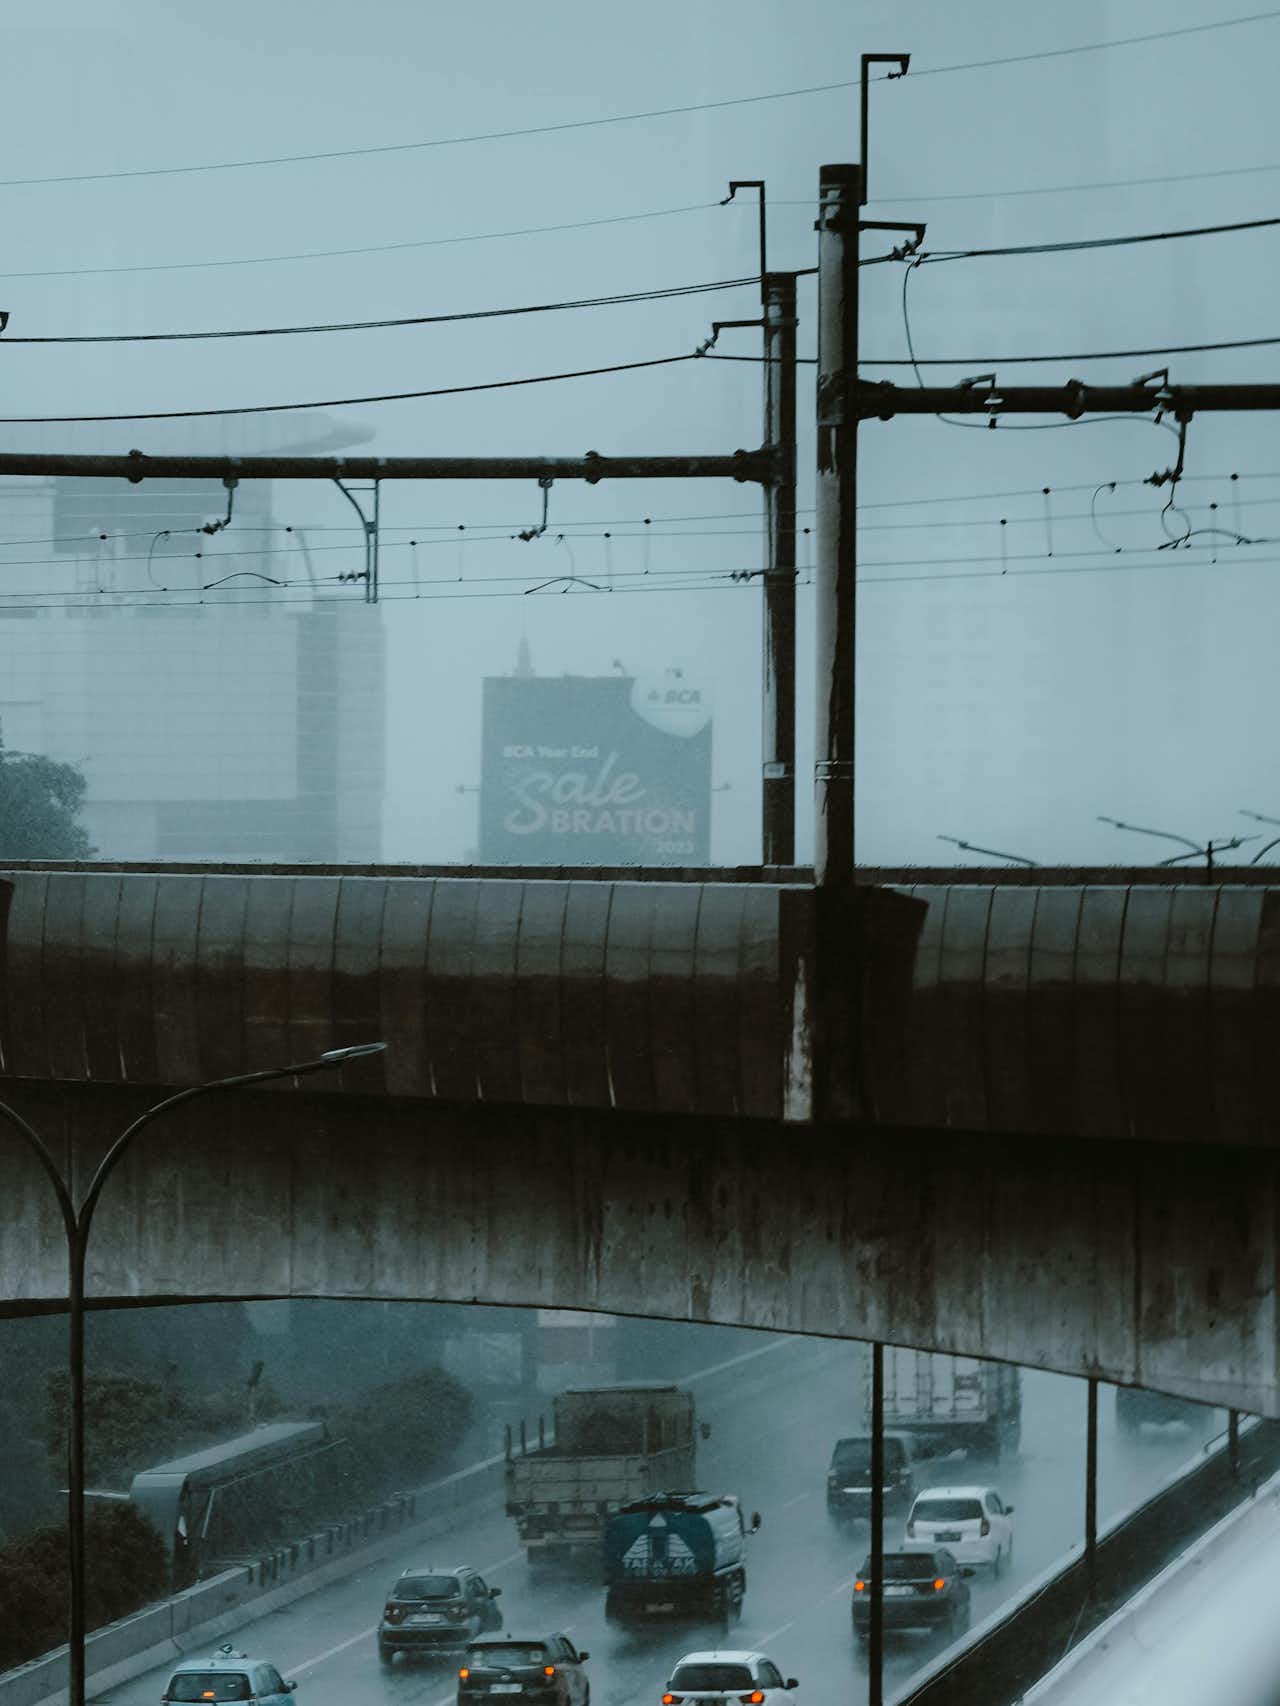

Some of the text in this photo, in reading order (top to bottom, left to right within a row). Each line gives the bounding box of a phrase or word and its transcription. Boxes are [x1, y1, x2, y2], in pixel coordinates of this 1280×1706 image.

[663, 689, 701, 705] BCA
[503, 750, 647, 835] Sale
[551, 809, 696, 834] BRATION
